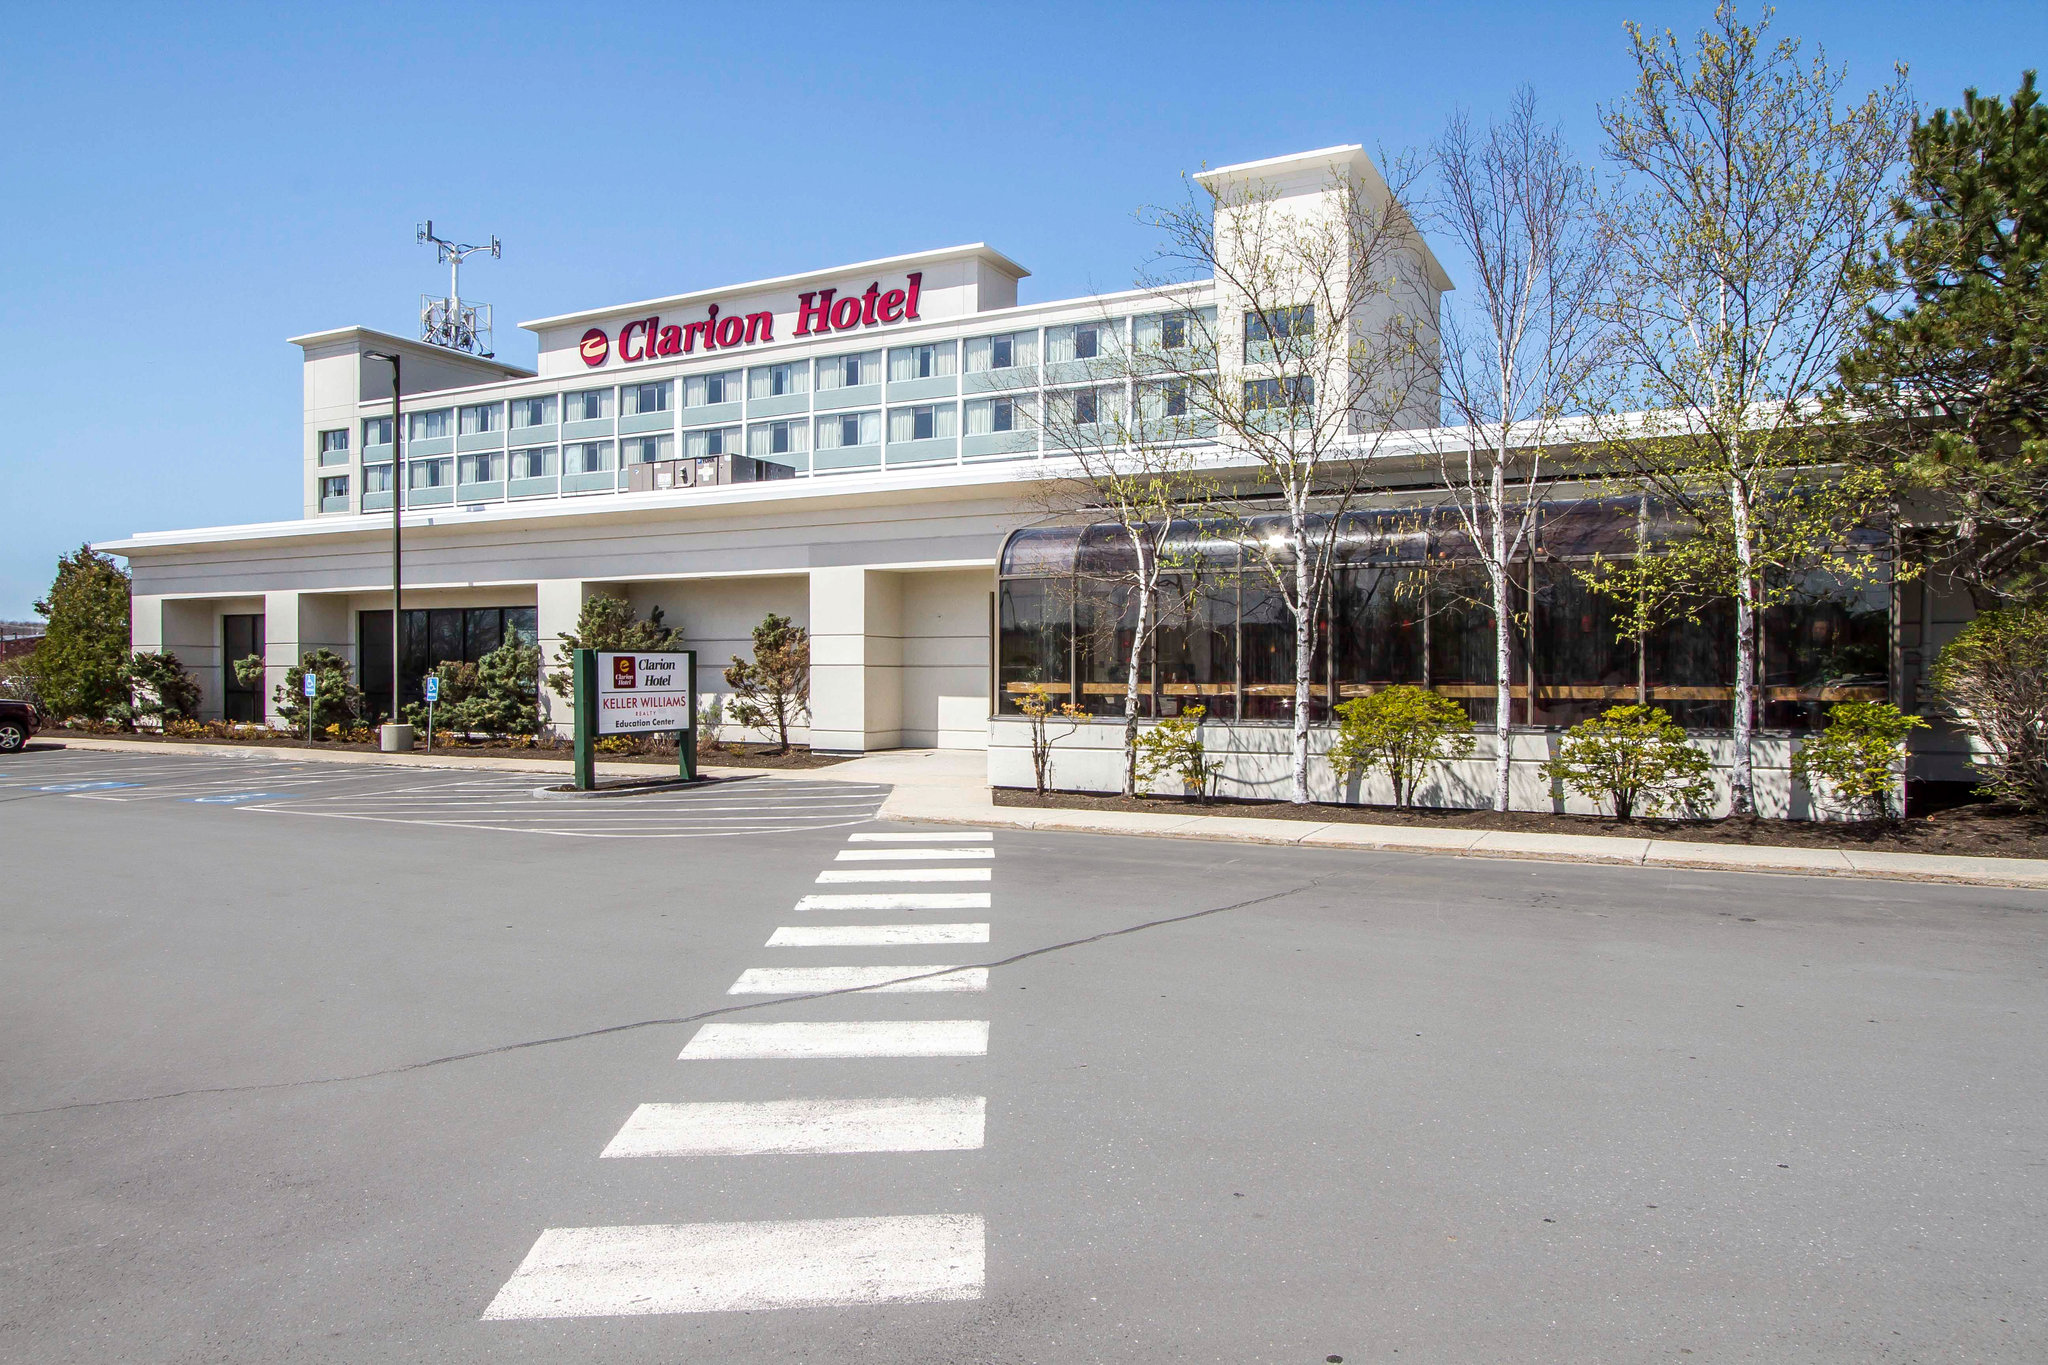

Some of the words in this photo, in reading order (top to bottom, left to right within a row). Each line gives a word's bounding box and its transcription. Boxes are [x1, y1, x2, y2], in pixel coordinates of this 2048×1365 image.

[618, 304, 774, 362] Clarion
[792, 272, 923, 335] Hotel
[639, 659, 675, 670] Clarion
[645, 674, 671, 686] Hotel
[603, 698, 638, 709] KELLER
[641, 696, 686, 707] WILLIAMS
[616, 720, 650, 728] Education
